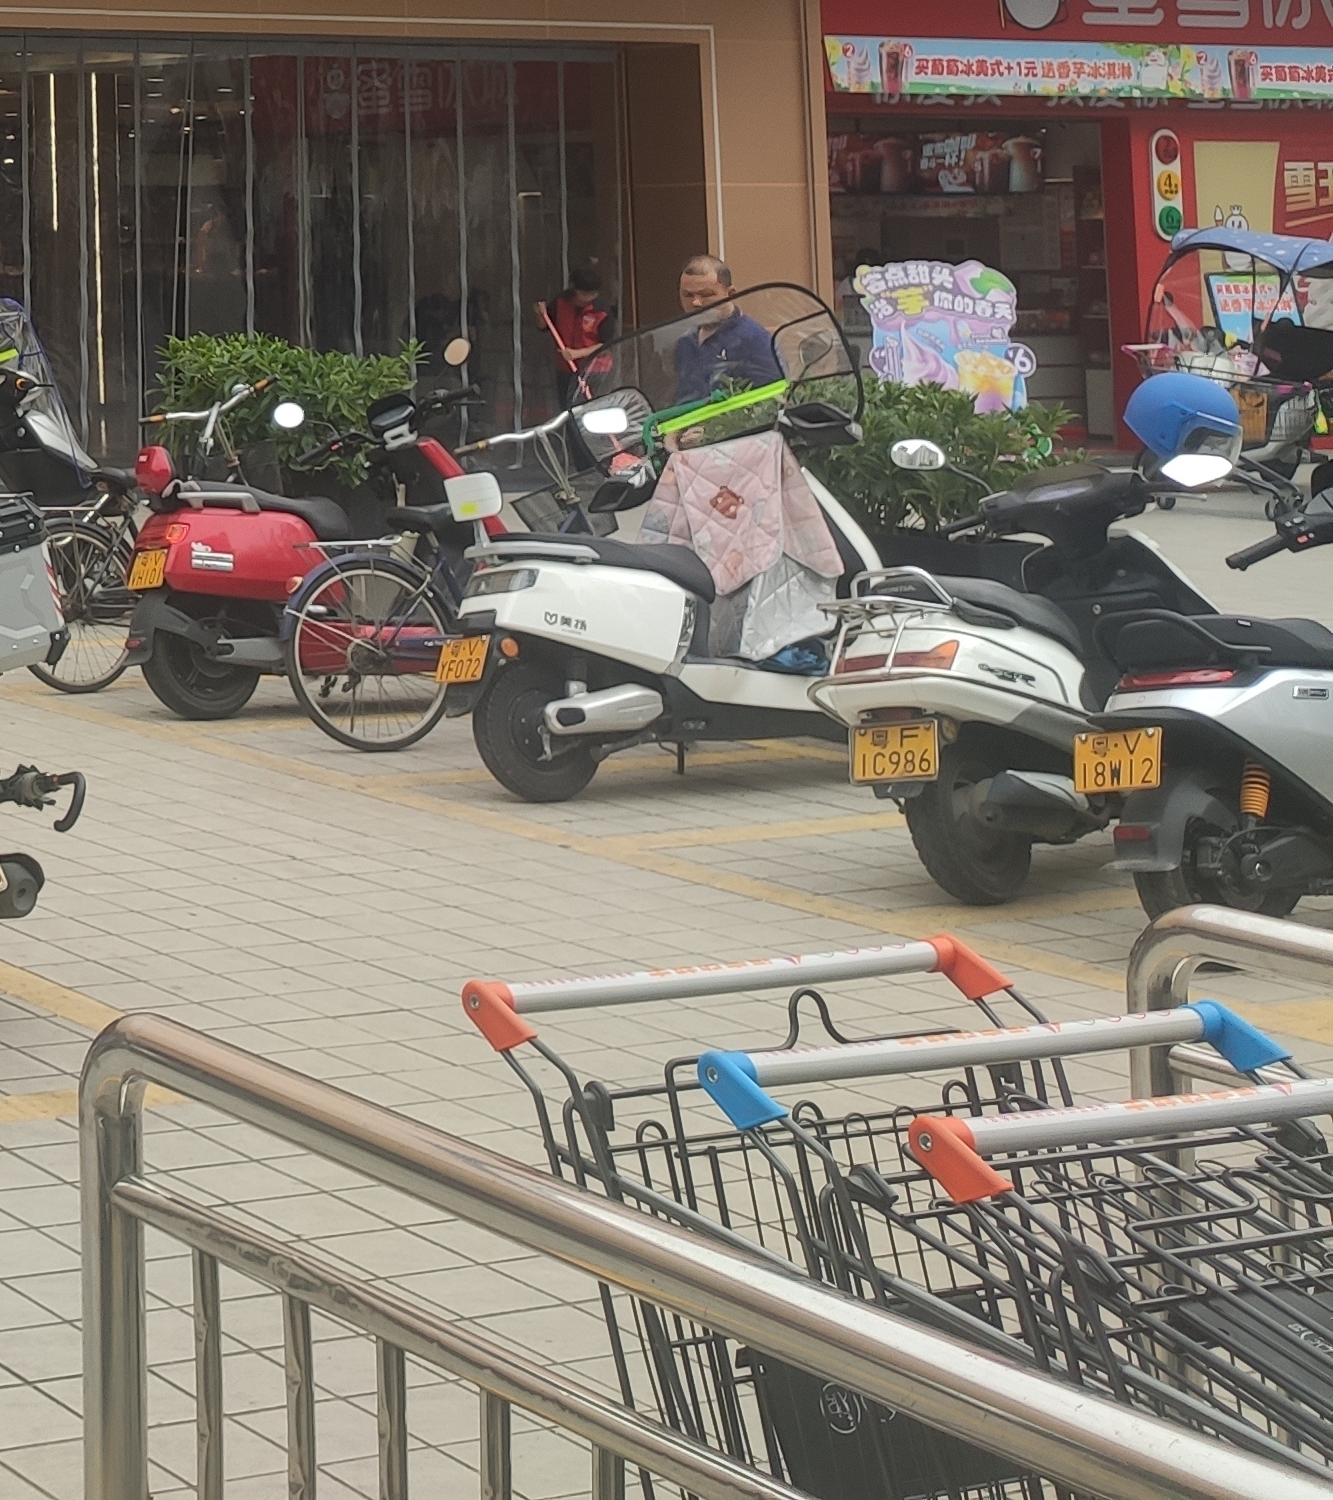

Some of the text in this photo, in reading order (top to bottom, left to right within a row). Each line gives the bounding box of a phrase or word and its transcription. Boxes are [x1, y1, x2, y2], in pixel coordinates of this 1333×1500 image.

[439, 657, 482, 681] YF072
[862, 748, 932, 778] 1C986
[1082, 757, 1155, 790] 18W12
